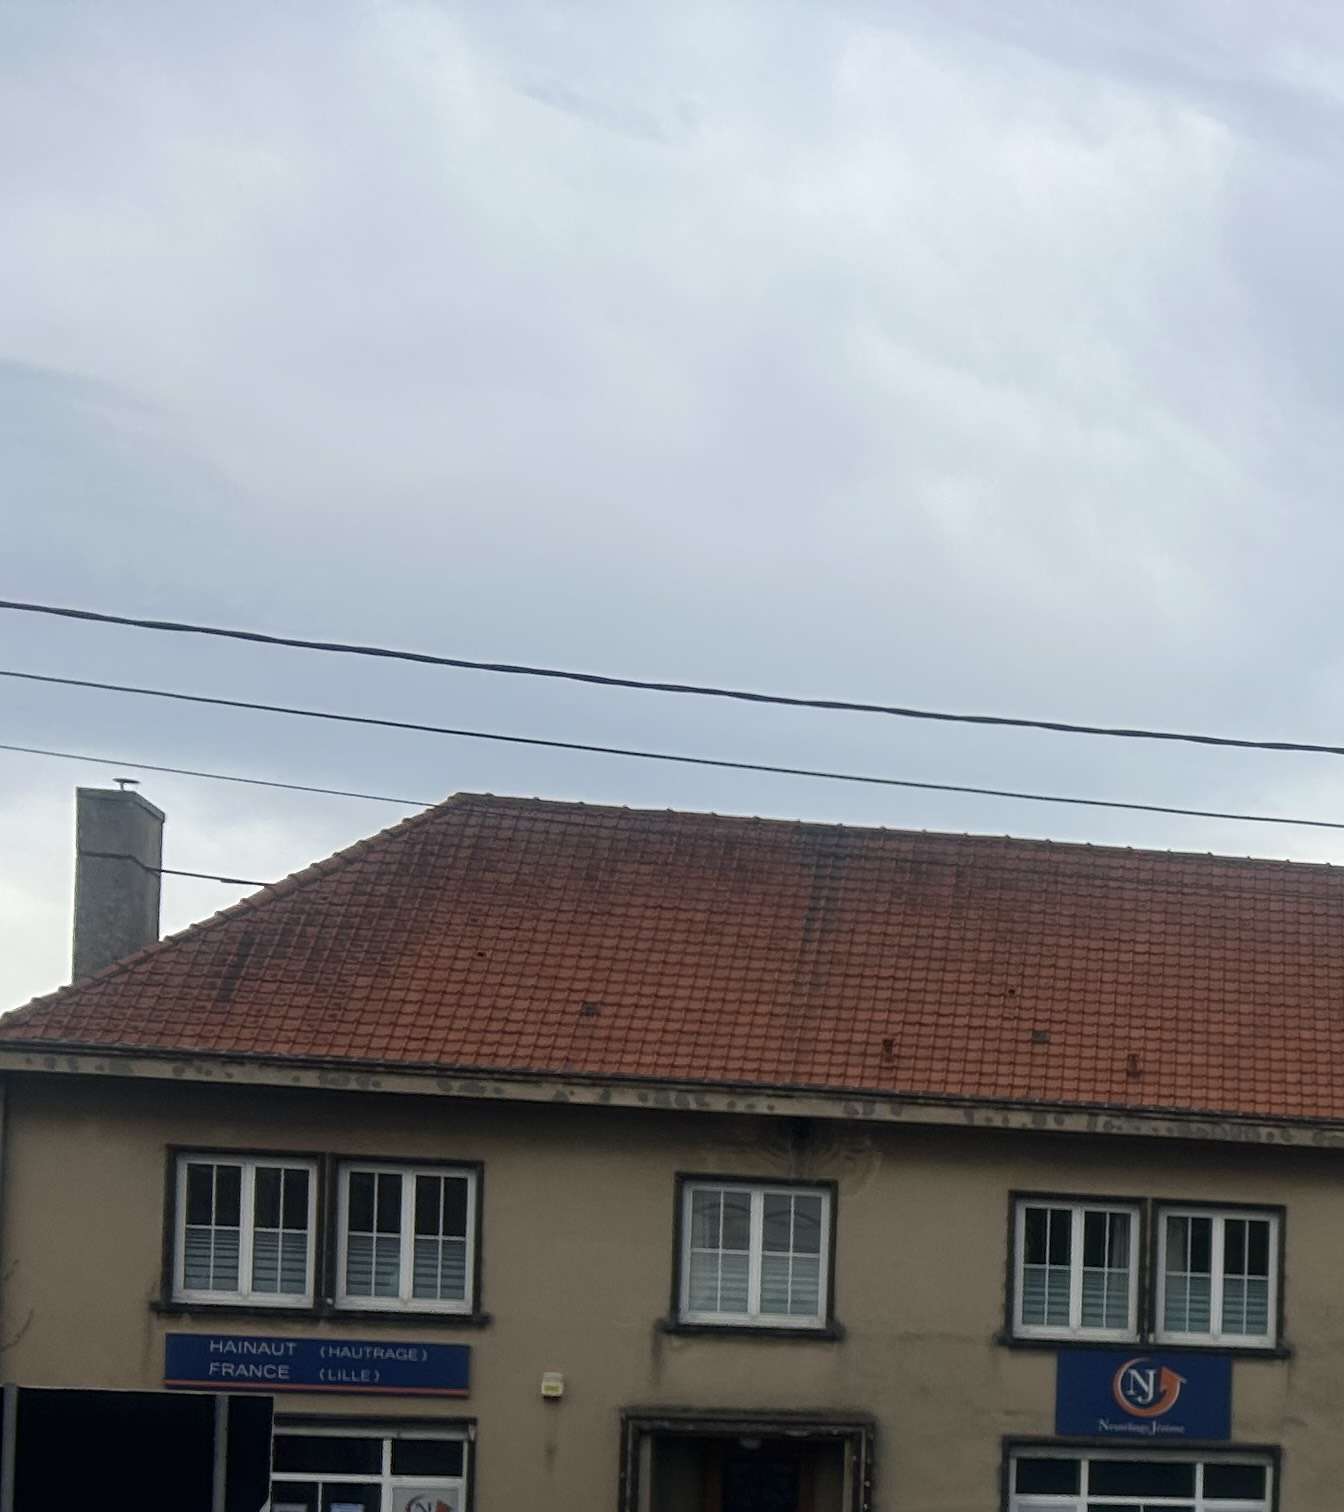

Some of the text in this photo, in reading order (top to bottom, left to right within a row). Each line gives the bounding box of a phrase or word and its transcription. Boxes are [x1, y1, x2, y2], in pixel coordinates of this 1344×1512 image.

[209, 1341, 296, 1356] HAINAUT
[208, 1362, 289, 1379] FRANCE
[1127, 1369, 1156, 1403] NJ
